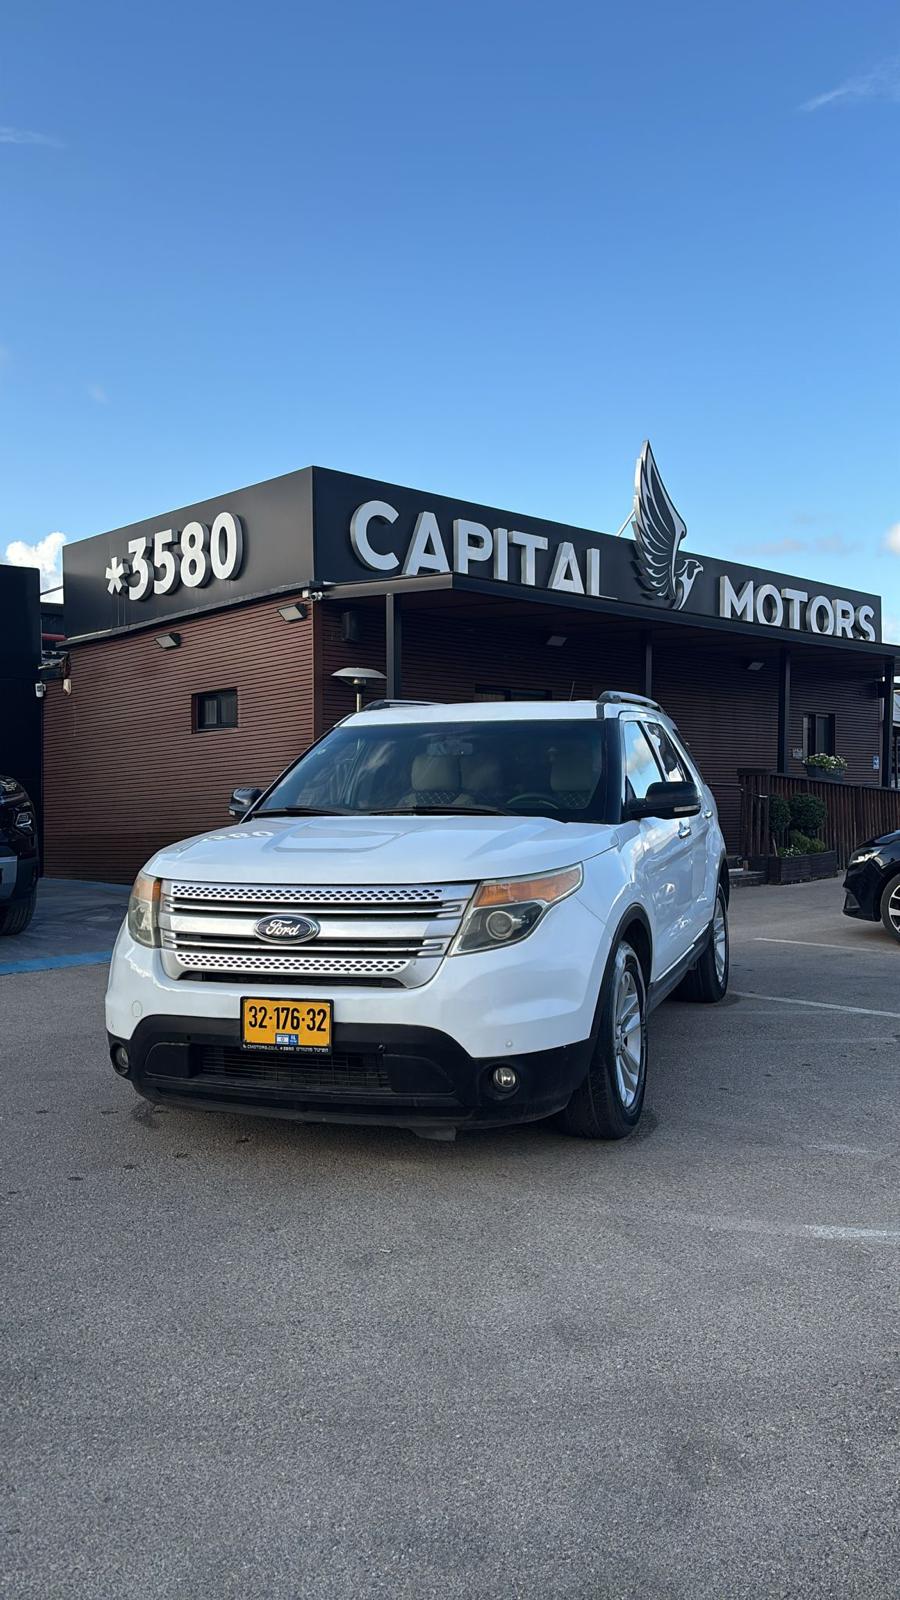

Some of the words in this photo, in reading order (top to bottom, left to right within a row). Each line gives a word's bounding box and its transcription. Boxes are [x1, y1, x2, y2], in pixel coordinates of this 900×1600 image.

[350, 500, 618, 600] CAPITAL
[720, 575, 876, 642] MOTORS
[265, 919, 301, 936] Ford
